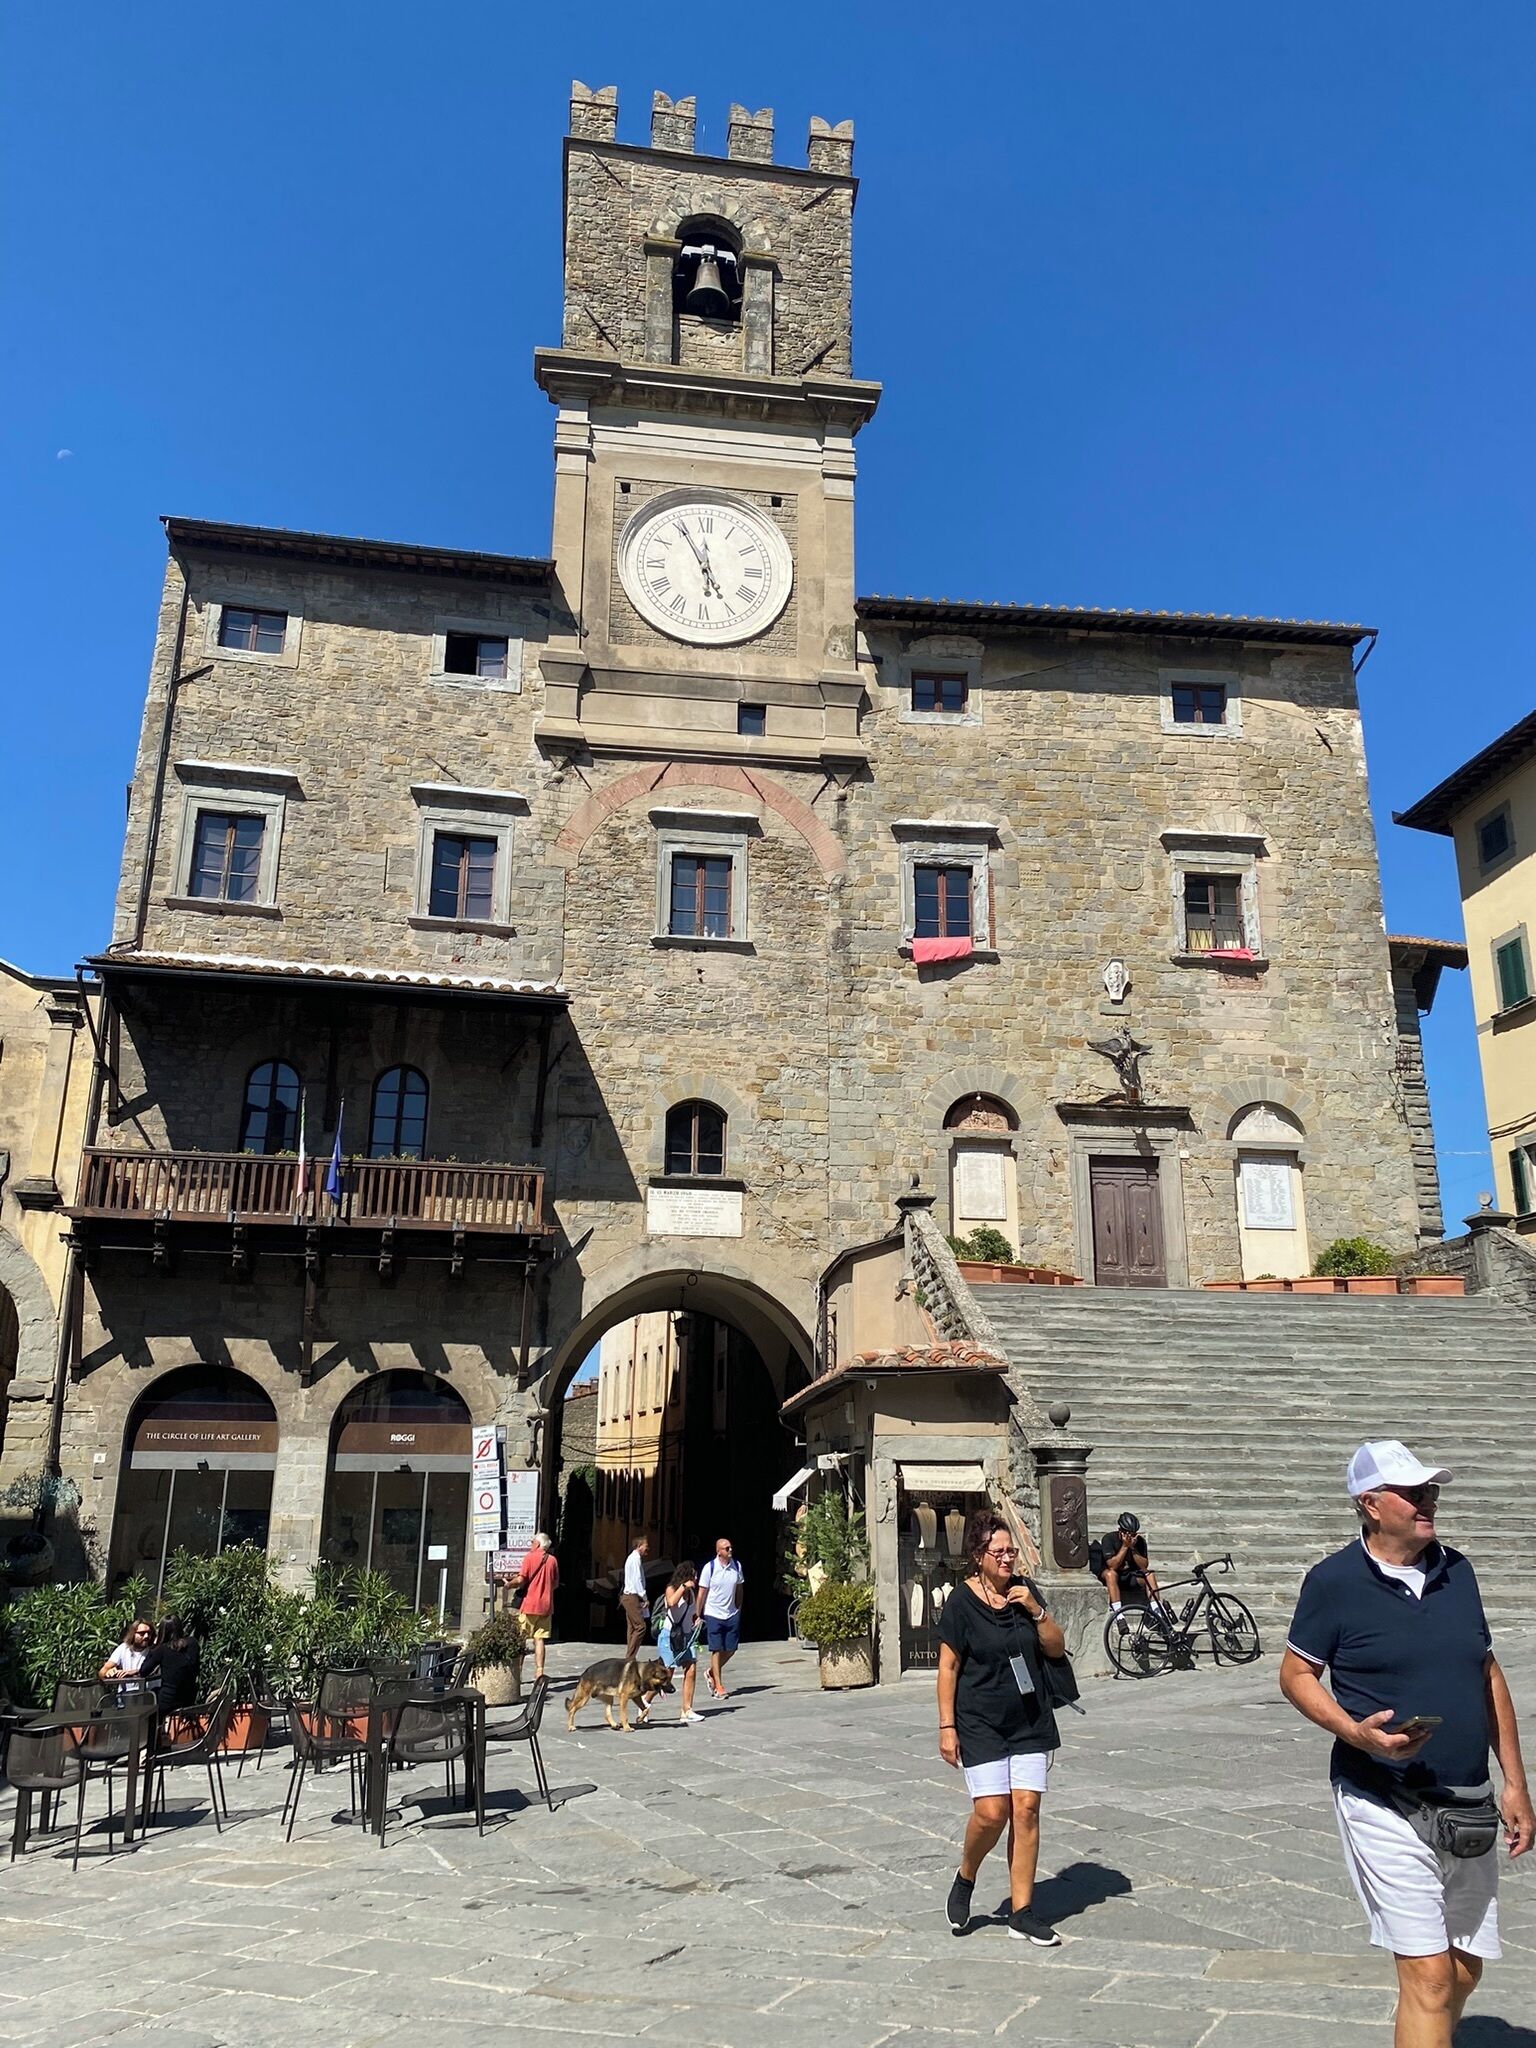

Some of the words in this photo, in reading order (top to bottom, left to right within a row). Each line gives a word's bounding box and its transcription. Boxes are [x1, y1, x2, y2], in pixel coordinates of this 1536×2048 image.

[697, 516, 713, 534] XII
[724, 526, 735, 540] I
[654, 535, 672, 550] X
[738, 545, 757, 556] II
[647, 557, 665, 568] IX
[744, 568, 762, 578] III
[650, 576, 672, 597] VIII
[735, 584, 757, 604] IIII
[669, 594, 686, 613] VII
[723, 601, 736, 618] V
[698, 604, 709, 620] VI
[146, 1432, 160, 1440] THE
[161, 1432, 187, 1440] CIRCLE
[216, 1433, 231, 1441] ART
[231, 1433, 262, 1441] GALLERY
[390, 1433, 416, 1442] ROGGI
[909, 1651, 938, 1660] FATTO
